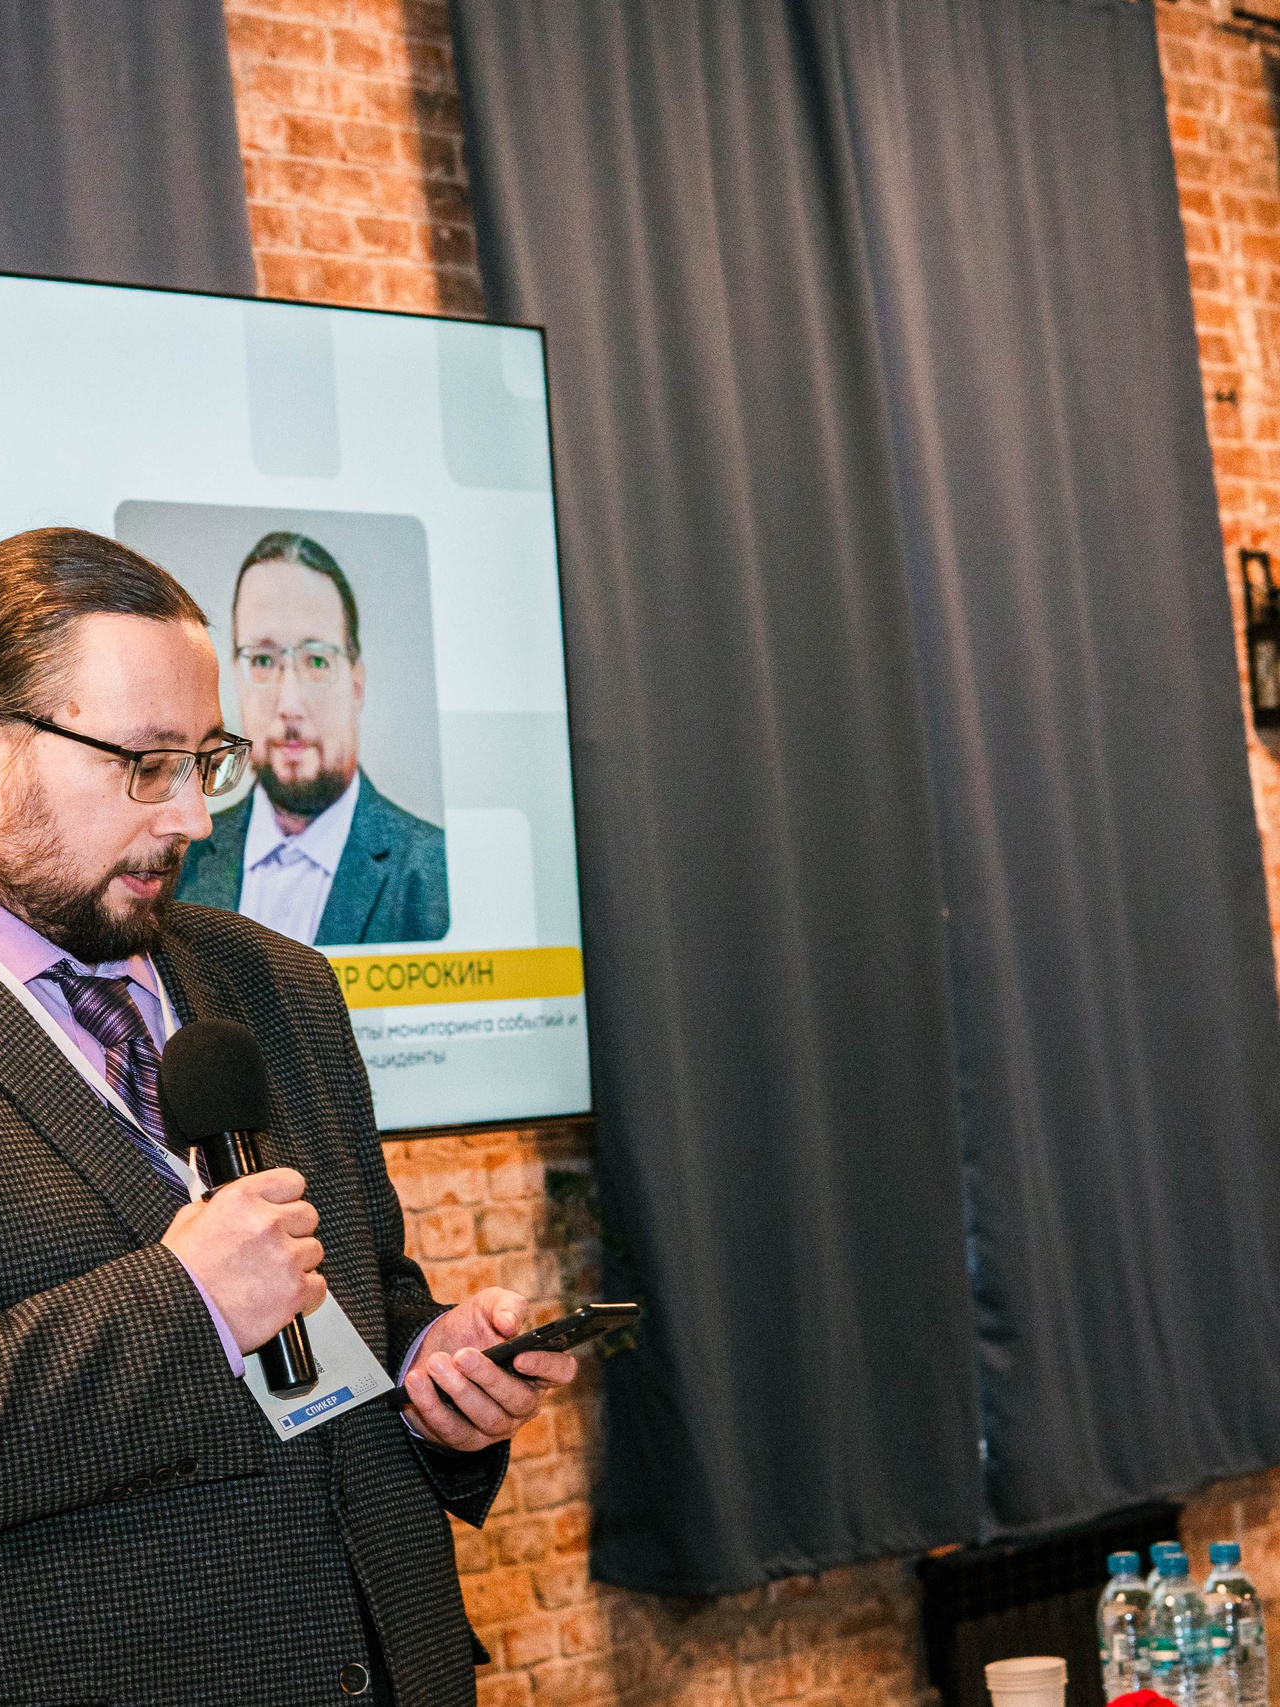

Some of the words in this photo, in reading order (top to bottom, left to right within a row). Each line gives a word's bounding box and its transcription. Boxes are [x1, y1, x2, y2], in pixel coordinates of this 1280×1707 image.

[366, 959, 495, 992] СОРОКИН
[386, 1018, 494, 1038] мониторинга
[305, 1395, 338, 1417] СПИКЕР
